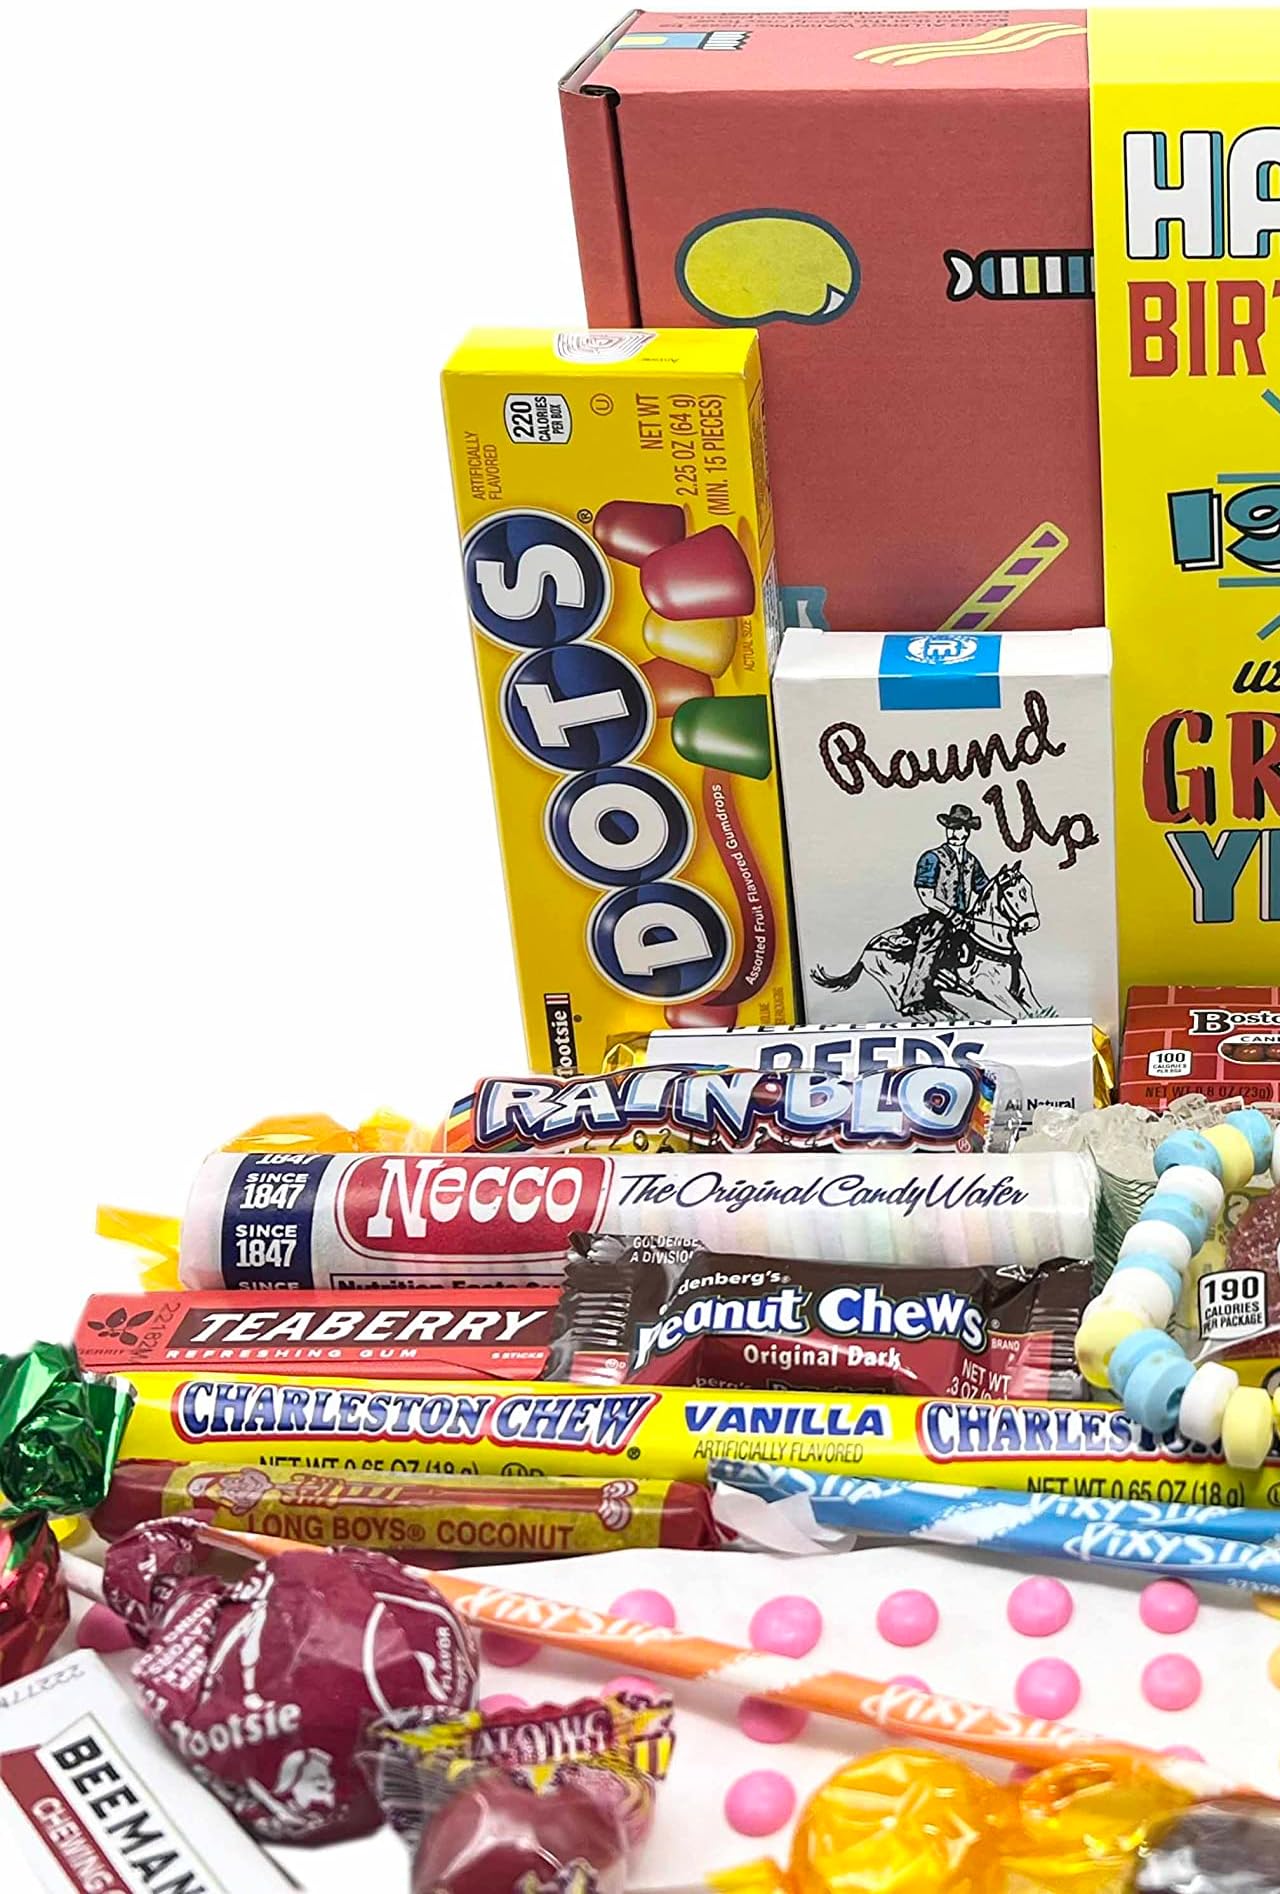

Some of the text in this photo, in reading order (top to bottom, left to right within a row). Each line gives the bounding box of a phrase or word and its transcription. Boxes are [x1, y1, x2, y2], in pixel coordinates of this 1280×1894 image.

[512, 401, 534, 438] 220
[539, 396, 549, 442] CALORIES
[552, 403, 563, 435] PER BOX
[636, 394, 663, 449] NET WT
[667, 394, 698, 496] 2.25 OZ (64 g)
[698, 394, 728, 516] (MIN. 15 PIECES)
[464, 432, 482, 500] ARTIFICIALLY
[489, 444, 501, 500] FLAVORED
[476, 544, 713, 977] DOTS
[819, 690, 1066, 795] Round
[982, 779, 1100, 870] Up
[712, 783, 767, 985] Assorted Fruit Flavored Gumdrops
[1156, 1052, 1186, 1063] 100
[1145, 1086, 1168, 1099] NET
[245, 1172, 309, 1184] SINCE
[618, 1171, 1029, 1218] The Original Candy Wafer
[240, 1184, 306, 1210] 1847
[366, 1158, 584, 1239] Necco
[235, 1224, 297, 1239] SINCE
[235, 1239, 297, 1268] 1847
[1204, 1276, 1259, 1304] 190
[189, 1308, 548, 1344] TEABERRY
[818, 1287, 988, 1353] Chews
[1205, 1300, 1260, 1320] CALORIES
[1220, 1311, 1263, 1329] PACKAGE
[165, 1348, 418, 1360] REFRESHING GUM
[744, 1344, 901, 1369] Original Dark
[991, 1338, 1020, 1352] BRAND
[962, 1358, 986, 1386] NET
[989, 1371, 1012, 1394] WT
[181, 1382, 885, 1449] CHARLESTON CHEW VANILLA
[693, 1441, 863, 1464] ARTIFICIALLY FLAVORED
[1027, 1477, 1068, 1494] NET
[1073, 1478, 1106, 1497] WT
[1111, 1479, 1152, 1500] 0.65
[1157, 1480, 1185, 1501] OZ
[1191, 1483, 1223, 1505] (18
[248, 1514, 322, 1541] LONG
[437, 1521, 574, 1552] COCONUT
[438, 1626, 452, 1693] FLAVOR
[171, 1701, 301, 1758] Tootsie
[30, 1797, 111, 1894] CHEWING
